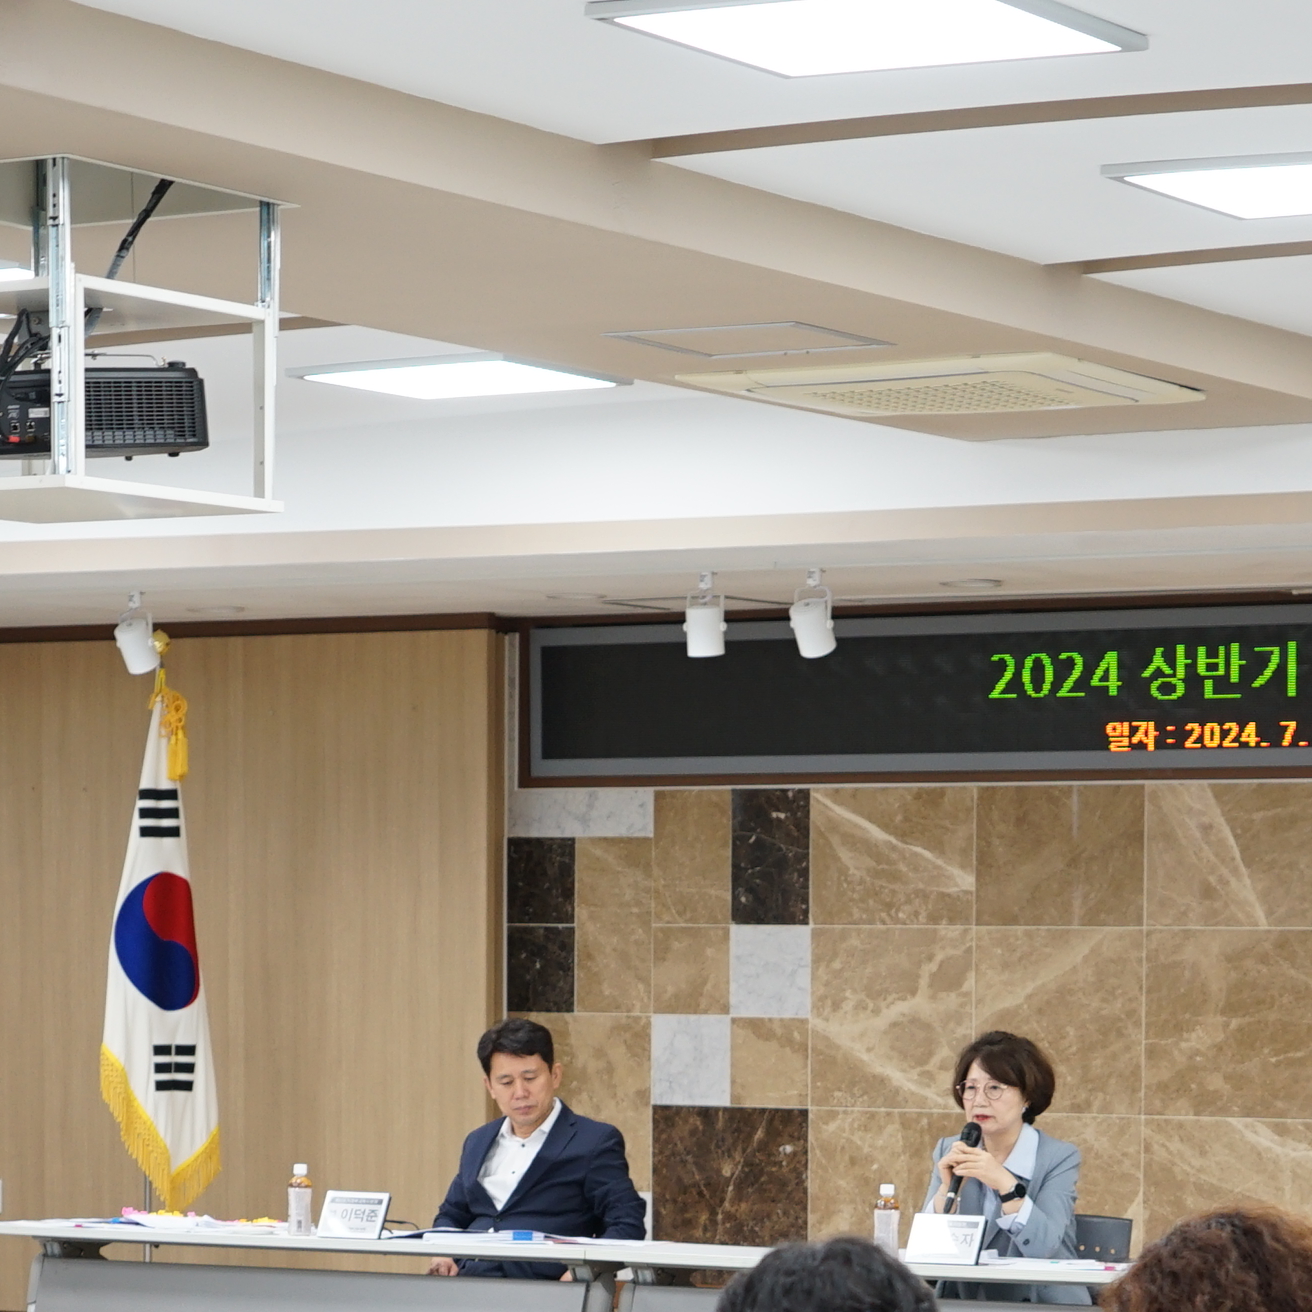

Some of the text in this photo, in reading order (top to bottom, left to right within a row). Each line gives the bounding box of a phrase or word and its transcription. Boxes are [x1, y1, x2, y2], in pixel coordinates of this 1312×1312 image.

[989, 651, 1123, 700] 2024
[1142, 641, 1298, 701] 상반기
[1106, 721, 1160, 752] 일자
[1184, 722, 1271, 748] 2024.
[1280, 721, 1309, 746] 7.
[340, 1207, 379, 1223] 이덕준
